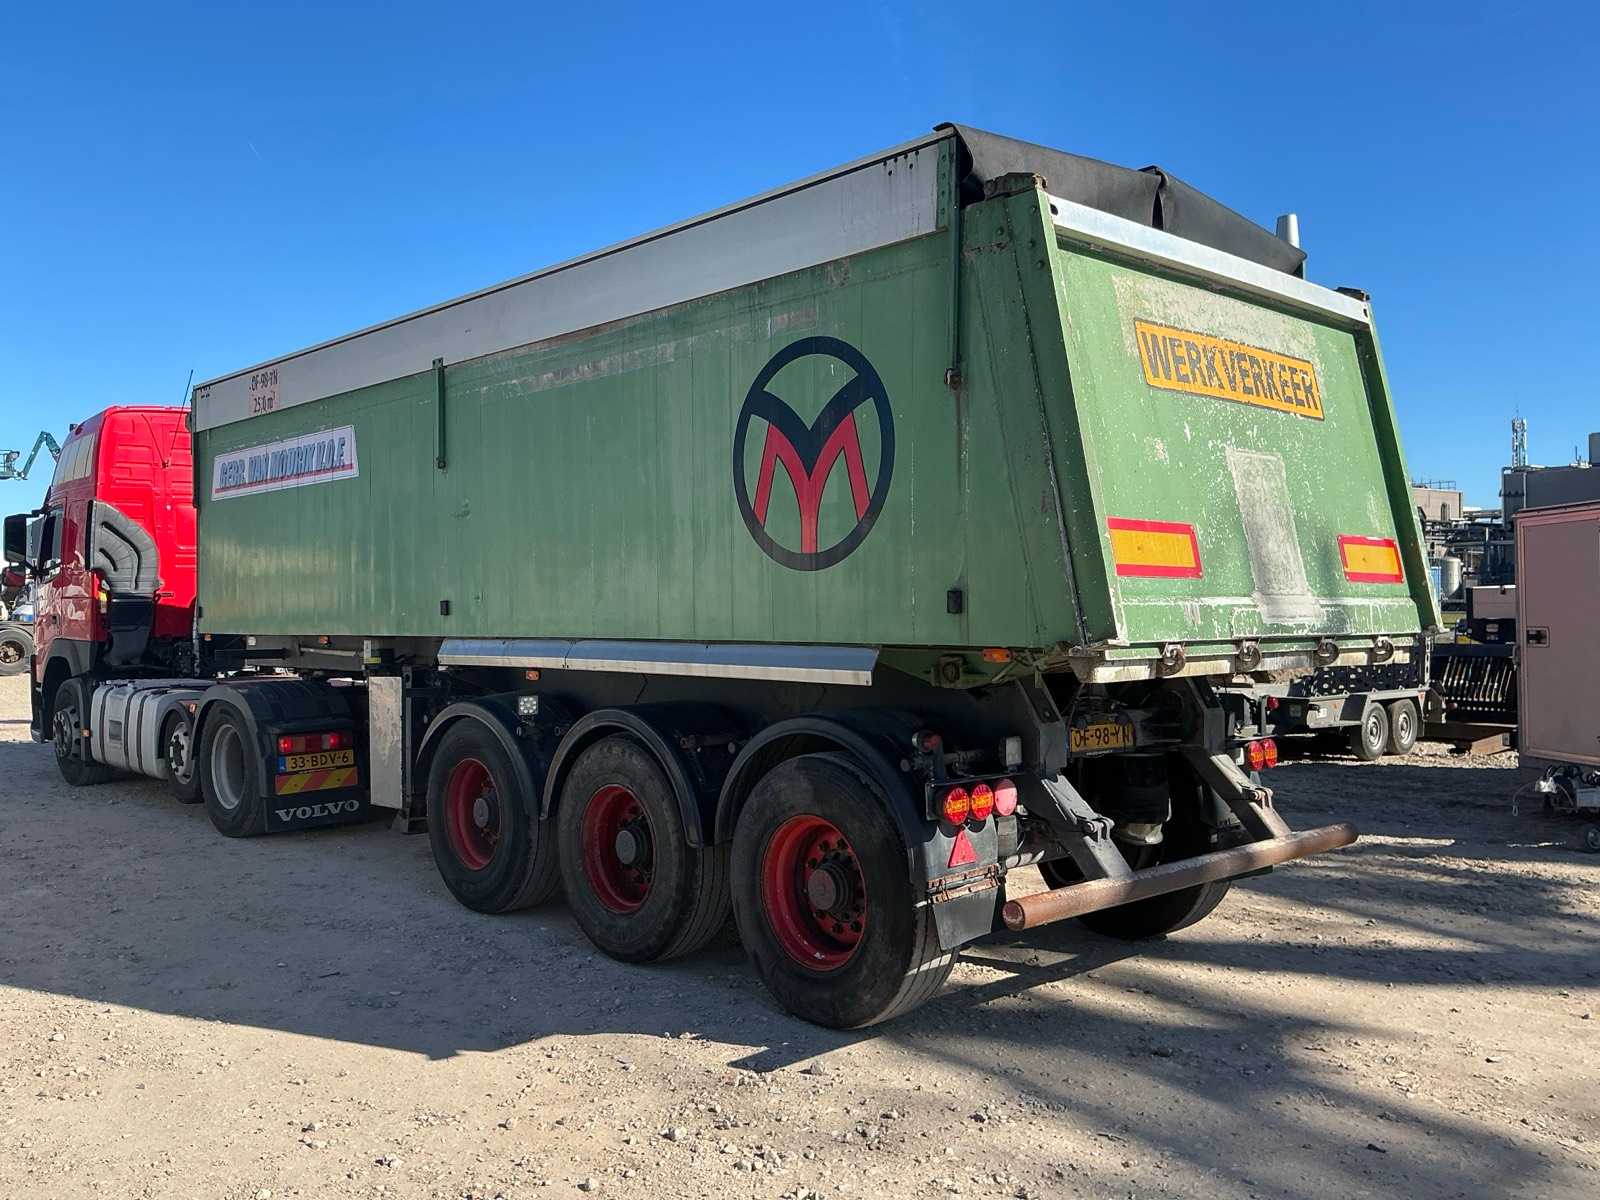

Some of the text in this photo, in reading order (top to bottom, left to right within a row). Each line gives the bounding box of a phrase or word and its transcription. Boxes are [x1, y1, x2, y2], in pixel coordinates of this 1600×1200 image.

[1140, 331, 1318, 411] WERKVERKEER
[250, 451, 270, 483] VAN
[290, 751, 349, 770] 33-BDV-6
[275, 799, 360, 822] VOLVO
